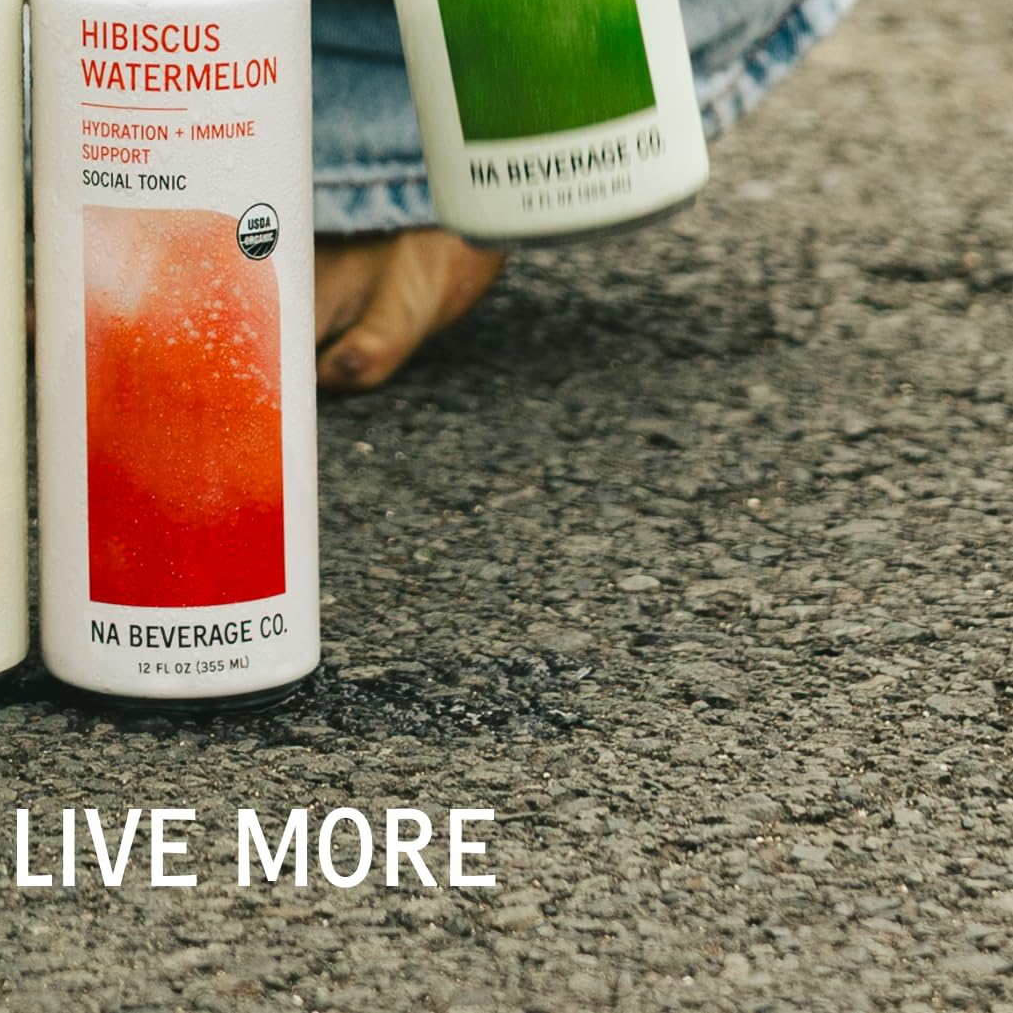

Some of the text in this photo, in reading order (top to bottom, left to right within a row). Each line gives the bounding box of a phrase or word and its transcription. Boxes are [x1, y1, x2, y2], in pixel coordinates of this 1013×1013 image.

[81, 19, 221, 53] HIBISCUS
[80, 56, 278, 92] WATERMELON
[81, 120, 169, 141] HYDRATION
[190, 120, 255, 140] IMMUNE
[81, 144, 151, 164] SUPPORT
[506, 138, 628, 184] BEVERAGE
[82, 169, 187, 191] SOCIAL TONIC
[248, 215, 271, 230] USDA
[91, 613, 288, 648] NA BEVERAGE CO.
[138, 655, 250, 675] 12 FL OZ (355 ML)
